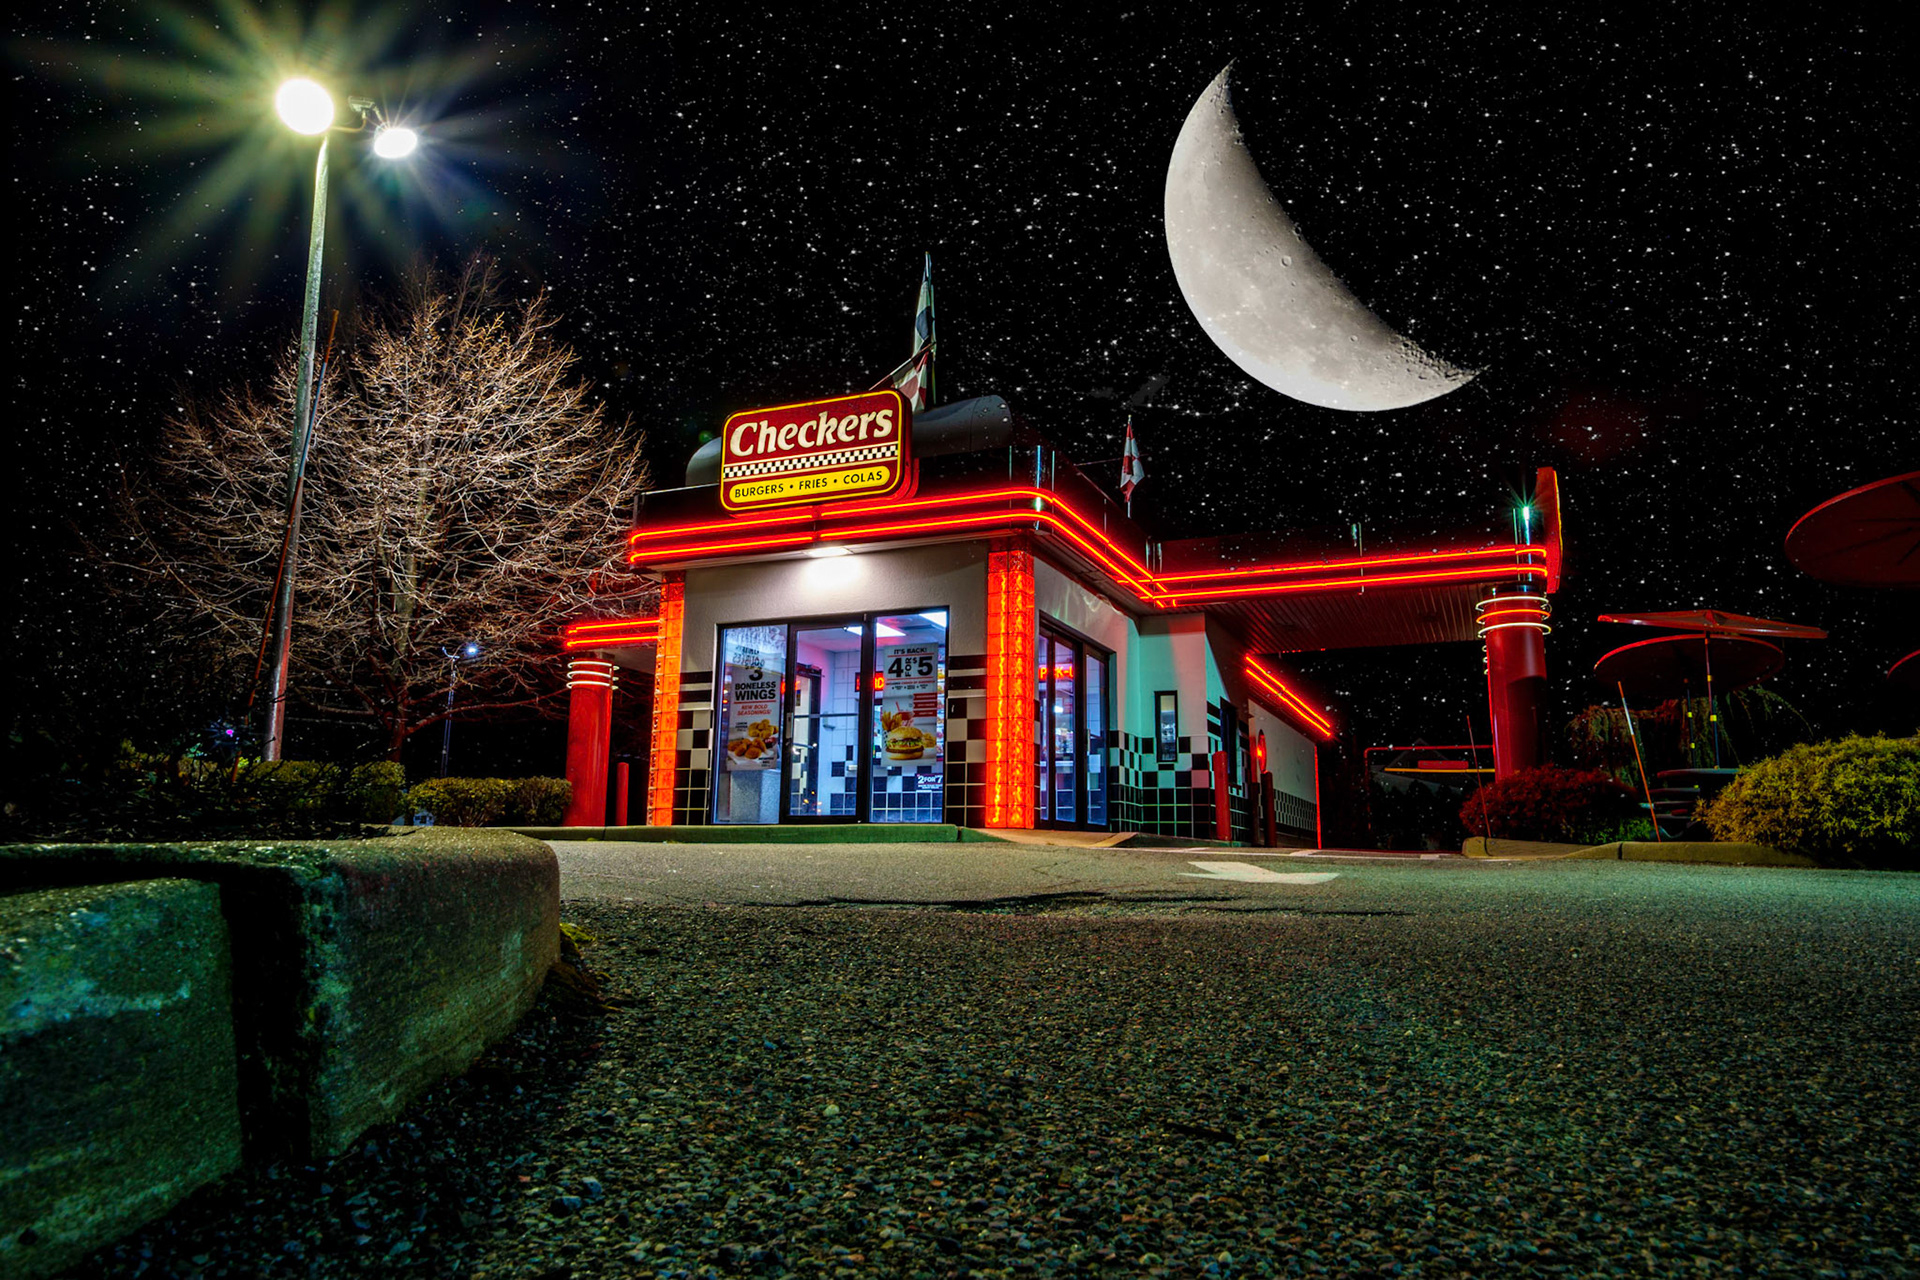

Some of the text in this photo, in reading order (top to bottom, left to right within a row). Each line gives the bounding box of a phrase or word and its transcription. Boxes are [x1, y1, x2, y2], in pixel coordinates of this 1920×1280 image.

[730, 409, 893, 457] Checkers
[735, 471, 883, 498] BURGERS FRIES COLAS
[888, 657, 904, 678] 4
[735, 681, 776, 690] BONELESS
[735, 689, 776, 700] WINGS
